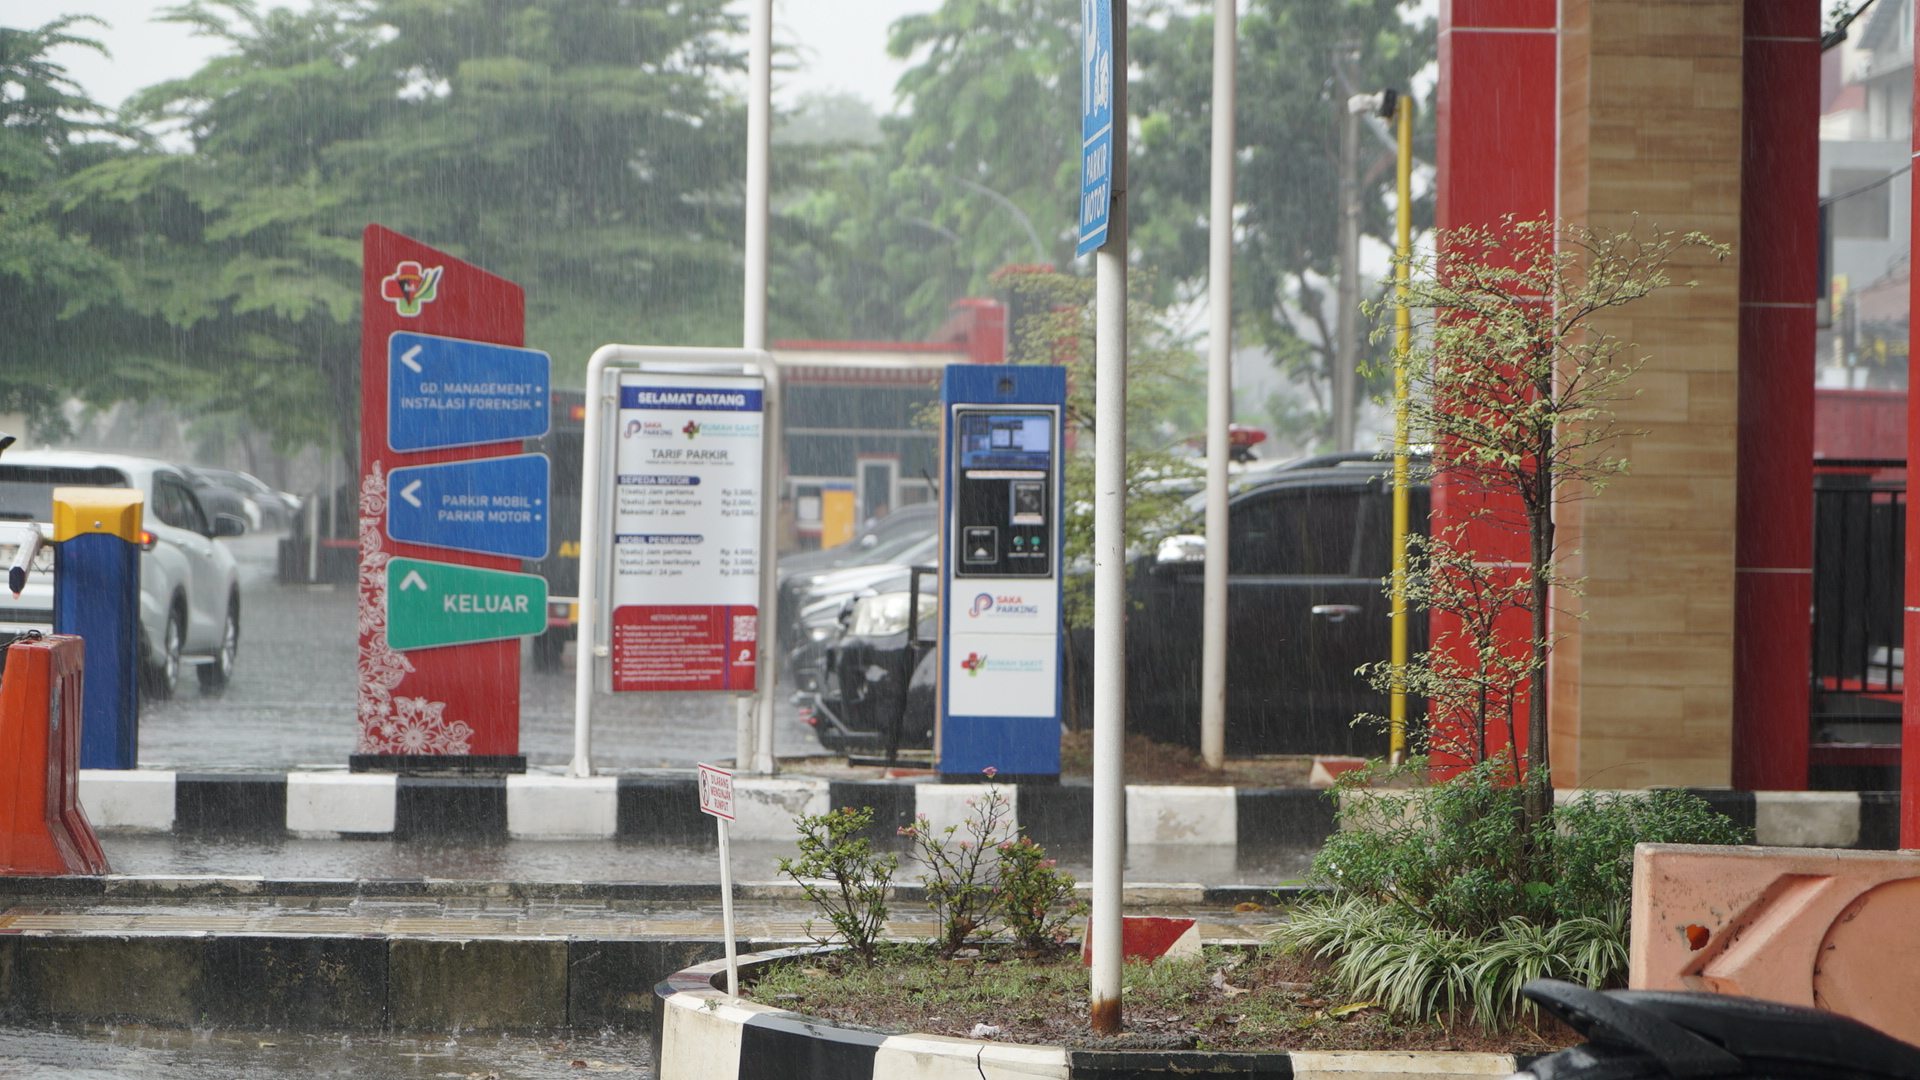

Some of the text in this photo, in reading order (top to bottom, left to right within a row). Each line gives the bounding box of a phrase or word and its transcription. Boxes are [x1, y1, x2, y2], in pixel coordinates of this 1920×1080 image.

[1086, 143, 1106, 187] PARKIR
[1084, 184, 1106, 227] MOTOR
[420, 382, 532, 395] GD. MANAGEMENT
[401, 397, 532, 410] INSTALASI FORENSIK
[638, 392, 745, 406] SELAMAT DATANG
[643, 429, 673, 437] PARKING
[735, 424, 759, 432] SAKIT
[651, 449, 728, 460] TARIF PARKIR
[657, 476, 690, 485] MOTOR
[442, 495, 531, 508] PARKIR MOBIL
[438, 510, 531, 523] PARKIR MOTOR
[443, 594, 529, 613] KELUAR
[996, 596, 1022, 604] SAKA
[996, 605, 1038, 614] PARKING
[711, 774, 729, 789] DILARANG
